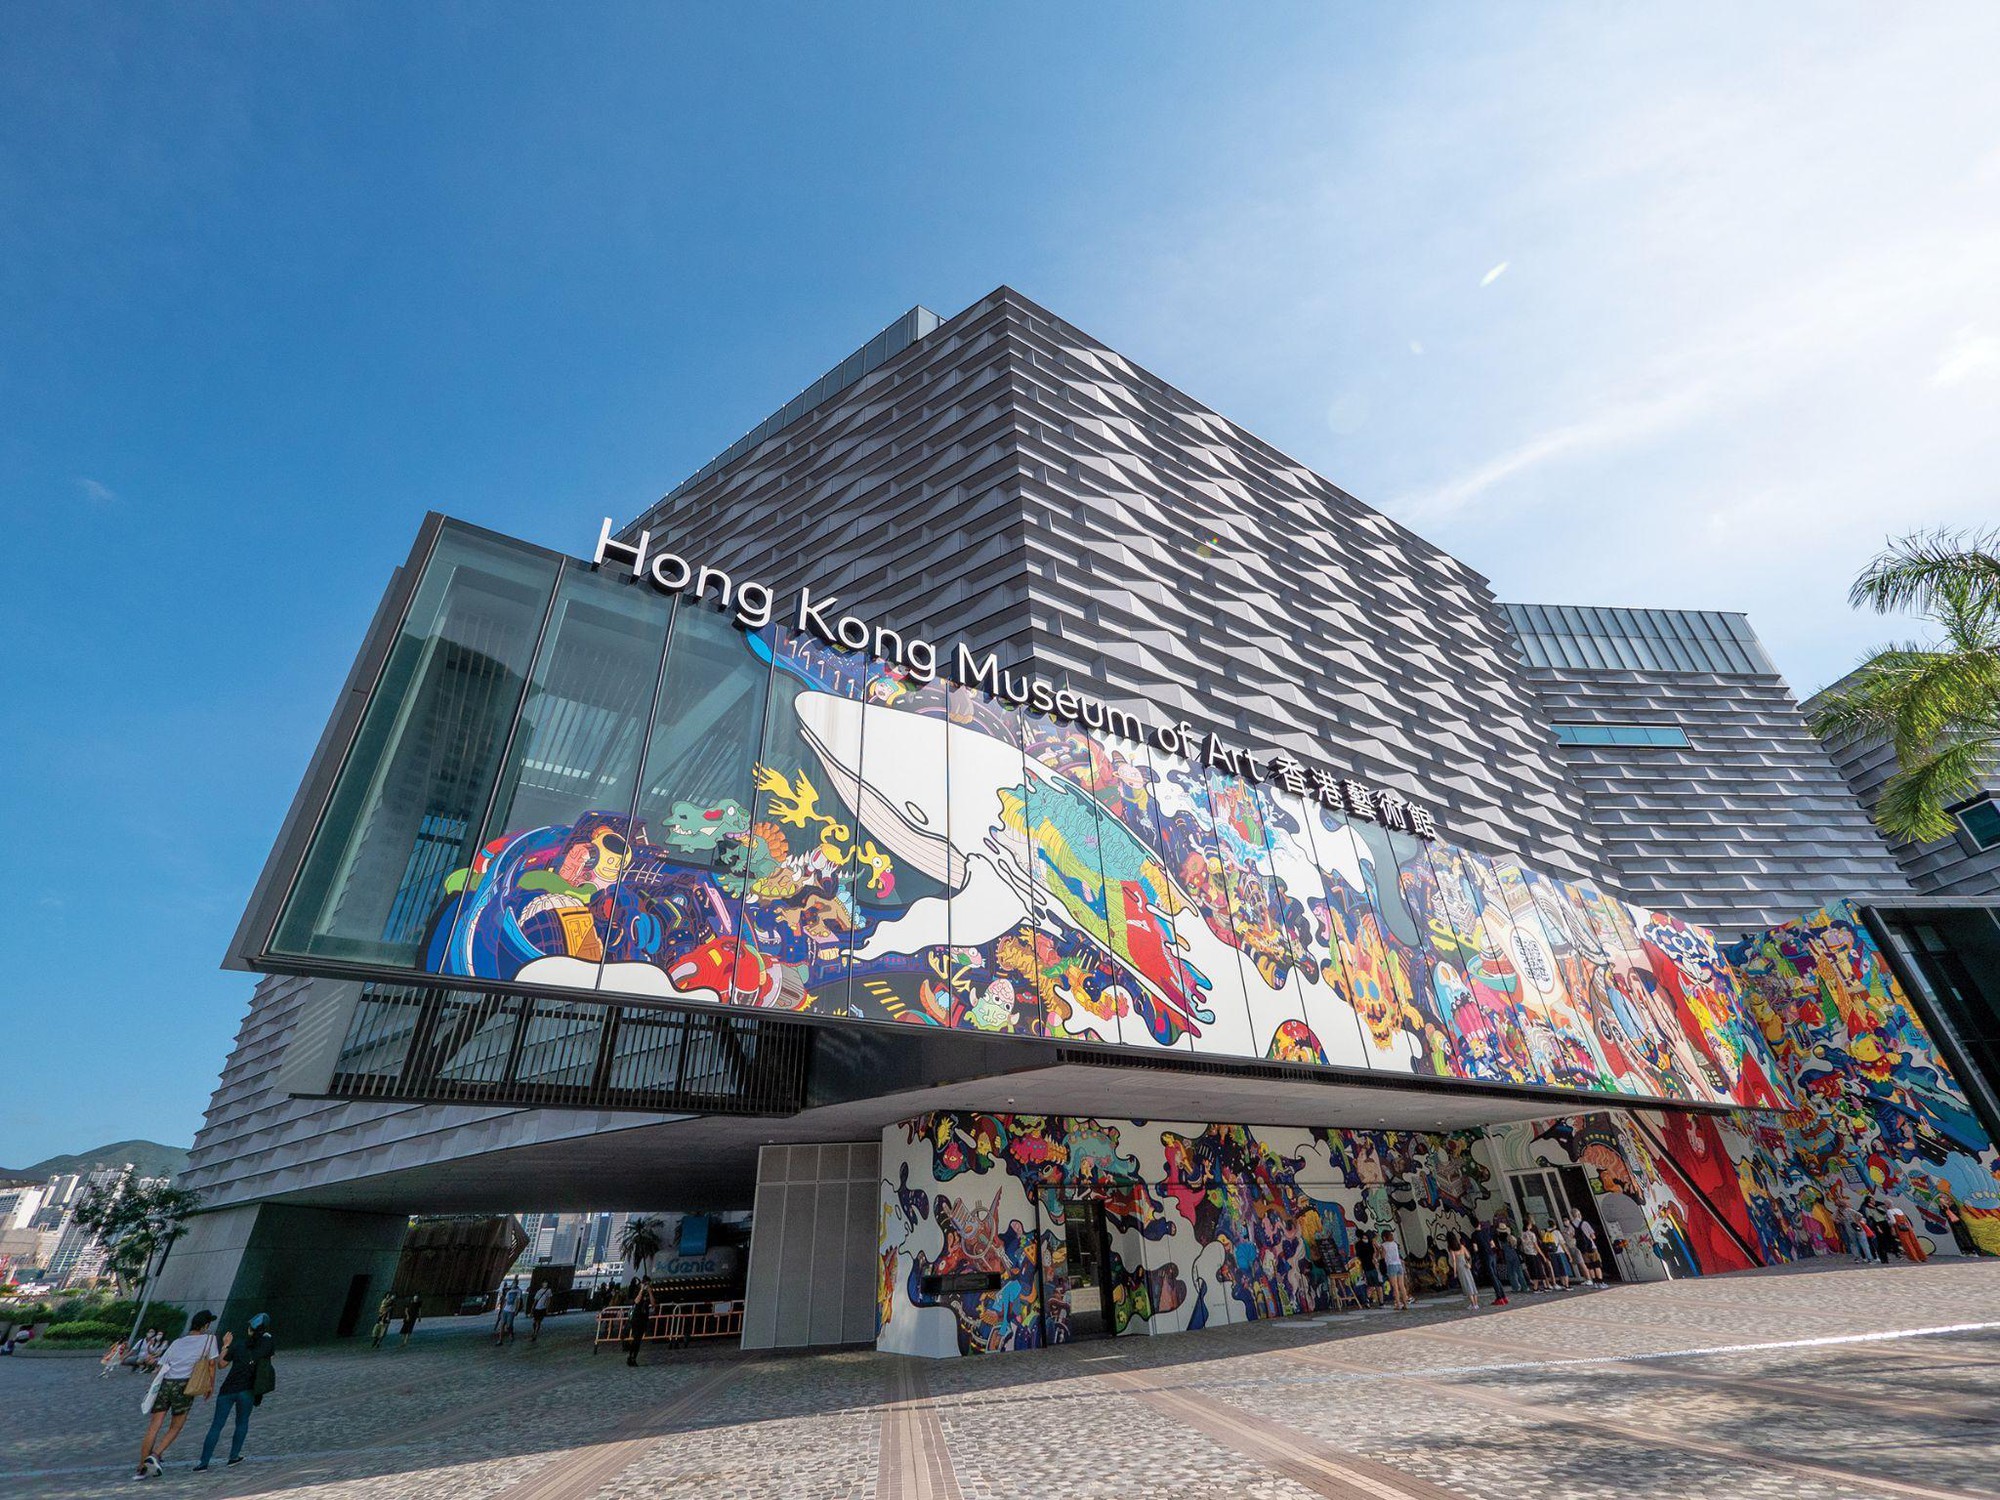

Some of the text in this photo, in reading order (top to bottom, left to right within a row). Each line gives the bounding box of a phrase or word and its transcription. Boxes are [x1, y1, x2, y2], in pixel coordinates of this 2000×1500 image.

[594, 517, 1437, 839] Hong Kong Museum of Art 香港藝術館
[668, 1258, 716, 1274] Genie
